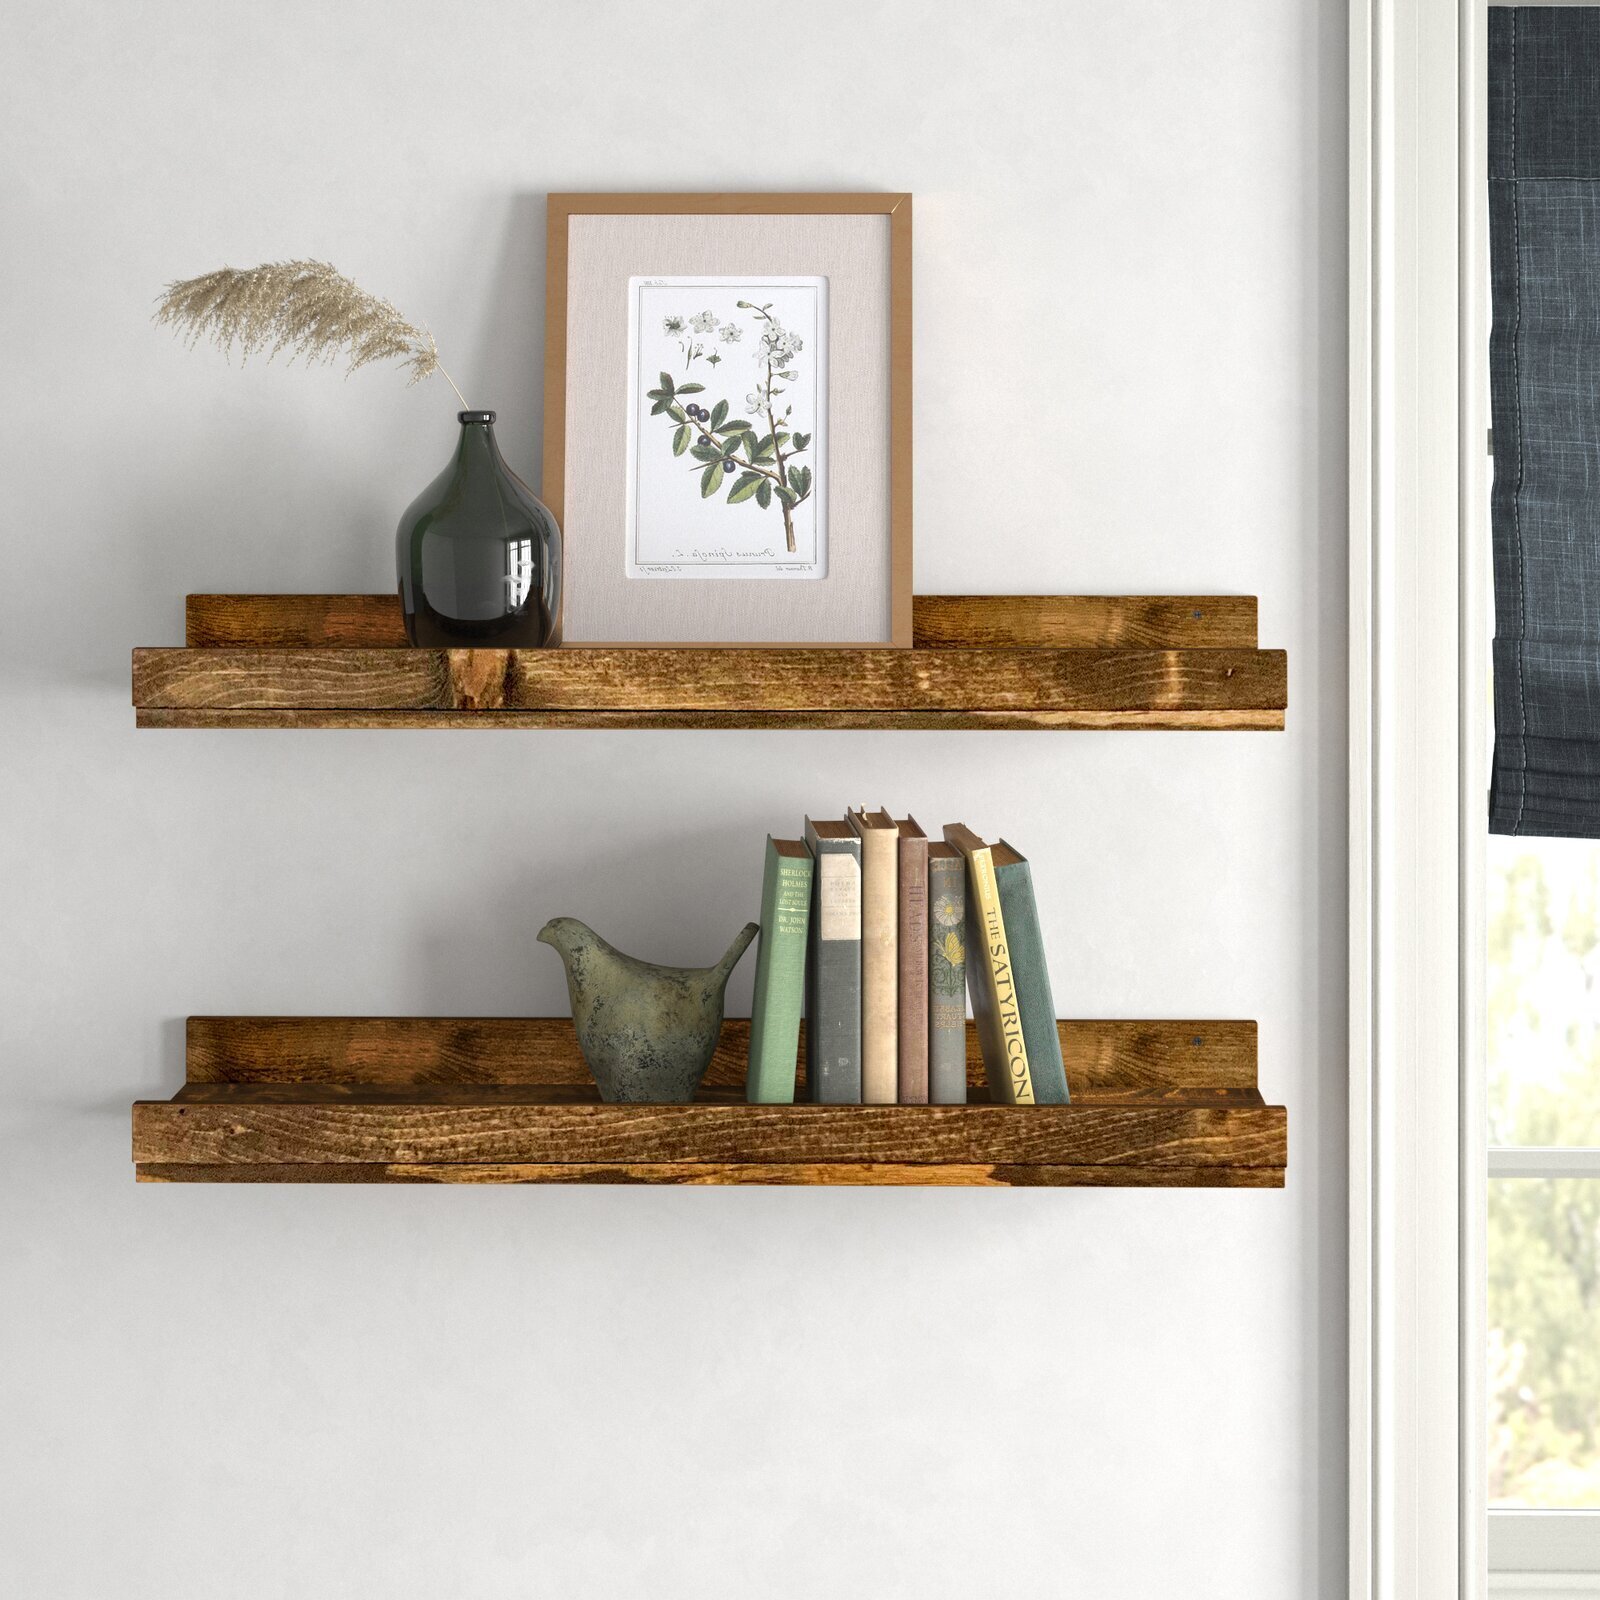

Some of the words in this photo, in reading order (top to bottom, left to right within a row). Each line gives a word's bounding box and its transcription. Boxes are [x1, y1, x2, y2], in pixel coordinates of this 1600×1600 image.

[780, 868, 811, 877] SHERLOCK
[782, 879, 808, 888] HOLMES
[789, 916, 806, 925] JOHN
[986, 907, 1001, 939] THE
[779, 925, 804, 934] WATSON
[990, 943, 1030, 1098] SATYRICON
